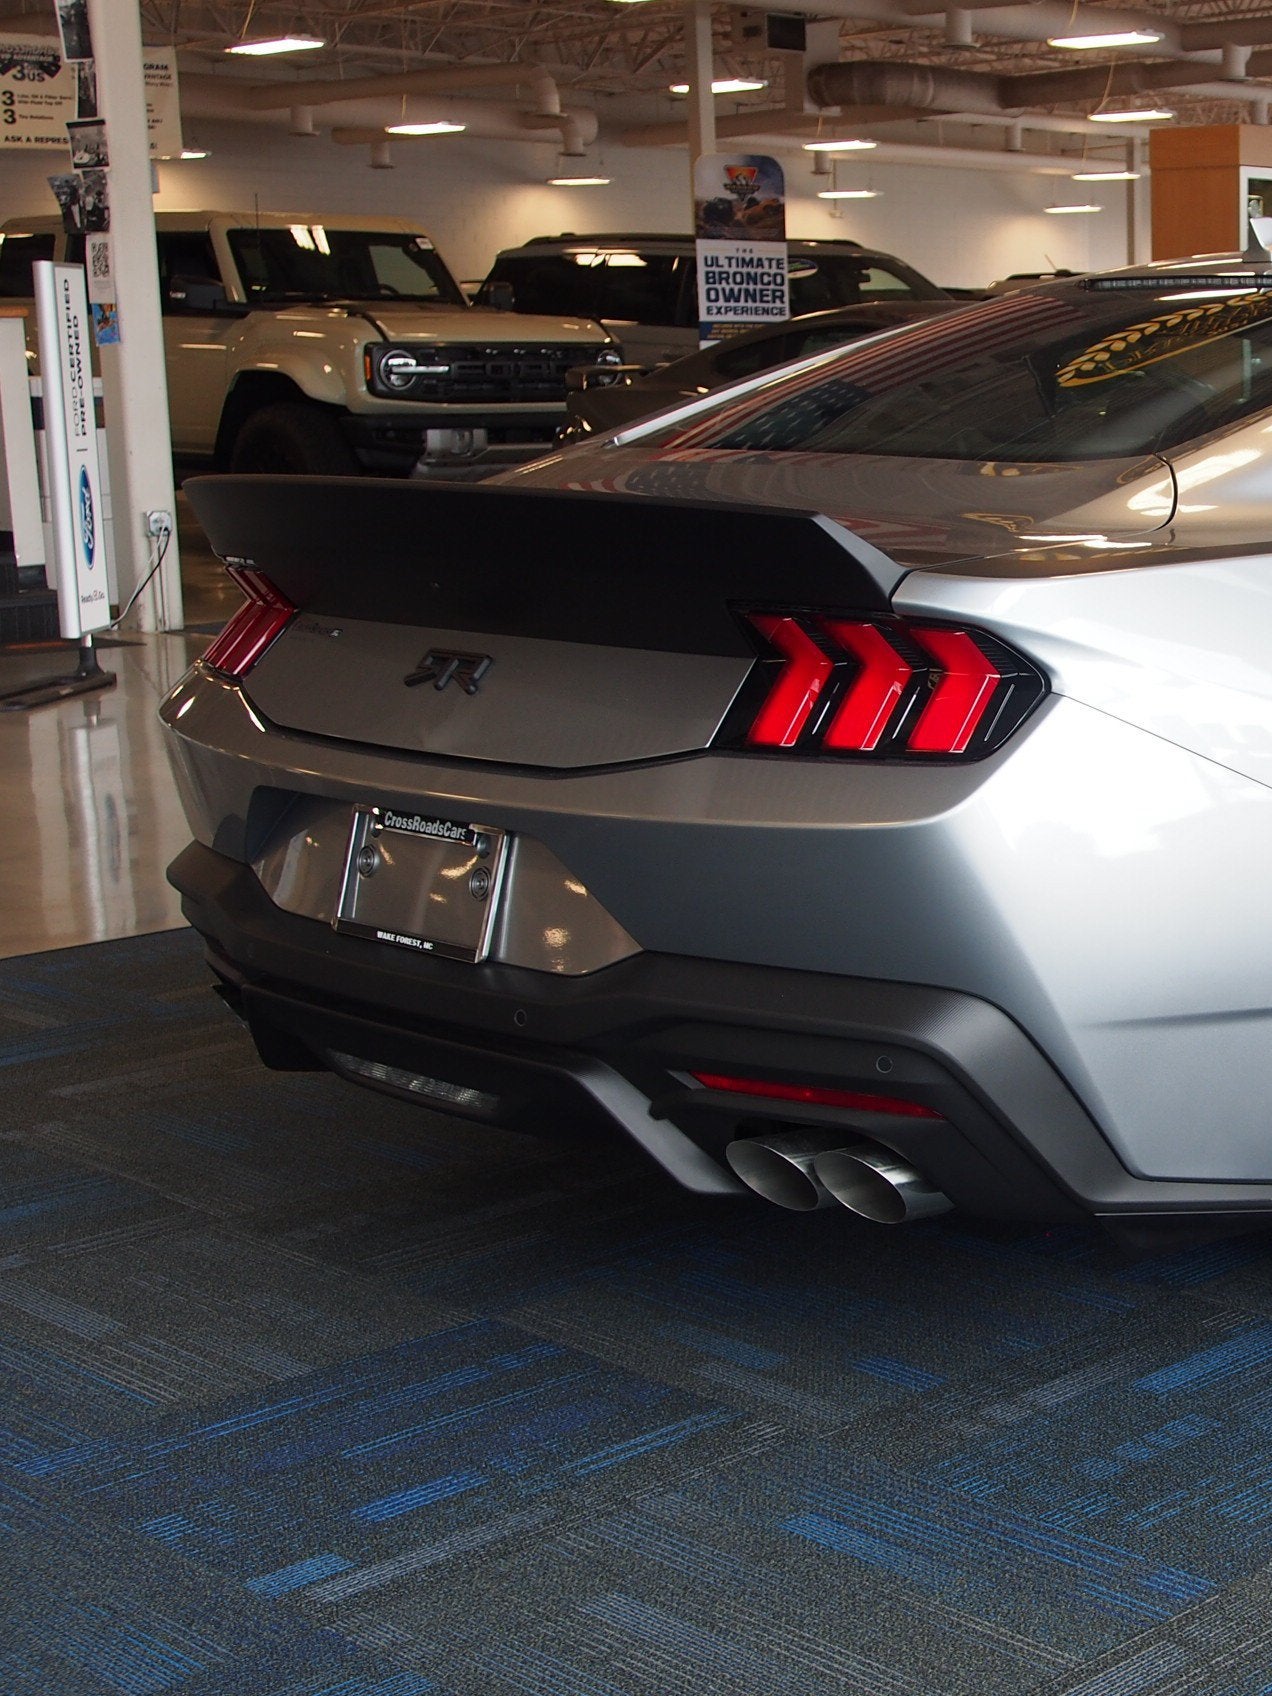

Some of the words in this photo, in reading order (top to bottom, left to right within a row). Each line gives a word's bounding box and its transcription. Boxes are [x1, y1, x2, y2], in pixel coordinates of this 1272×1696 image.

[2, 90, 15, 106] 3
[3, 108, 17, 125] 3
[5, 135, 23, 143] ASK
[704, 256, 785, 270] ULTIMATE
[705, 270, 785, 287] BRONCO
[706, 287, 785, 304] OWNER
[706, 306, 787, 317] EXPERIENCE
[64, 279, 77, 383] CERTIFIED
[73, 315, 87, 436] PRE-OWNED
[72, 387, 81, 436] FORD
[377, 930, 395, 942] WAKE
[396, 935, 422, 949] FOREST,
[423, 941, 433, 950] NC
